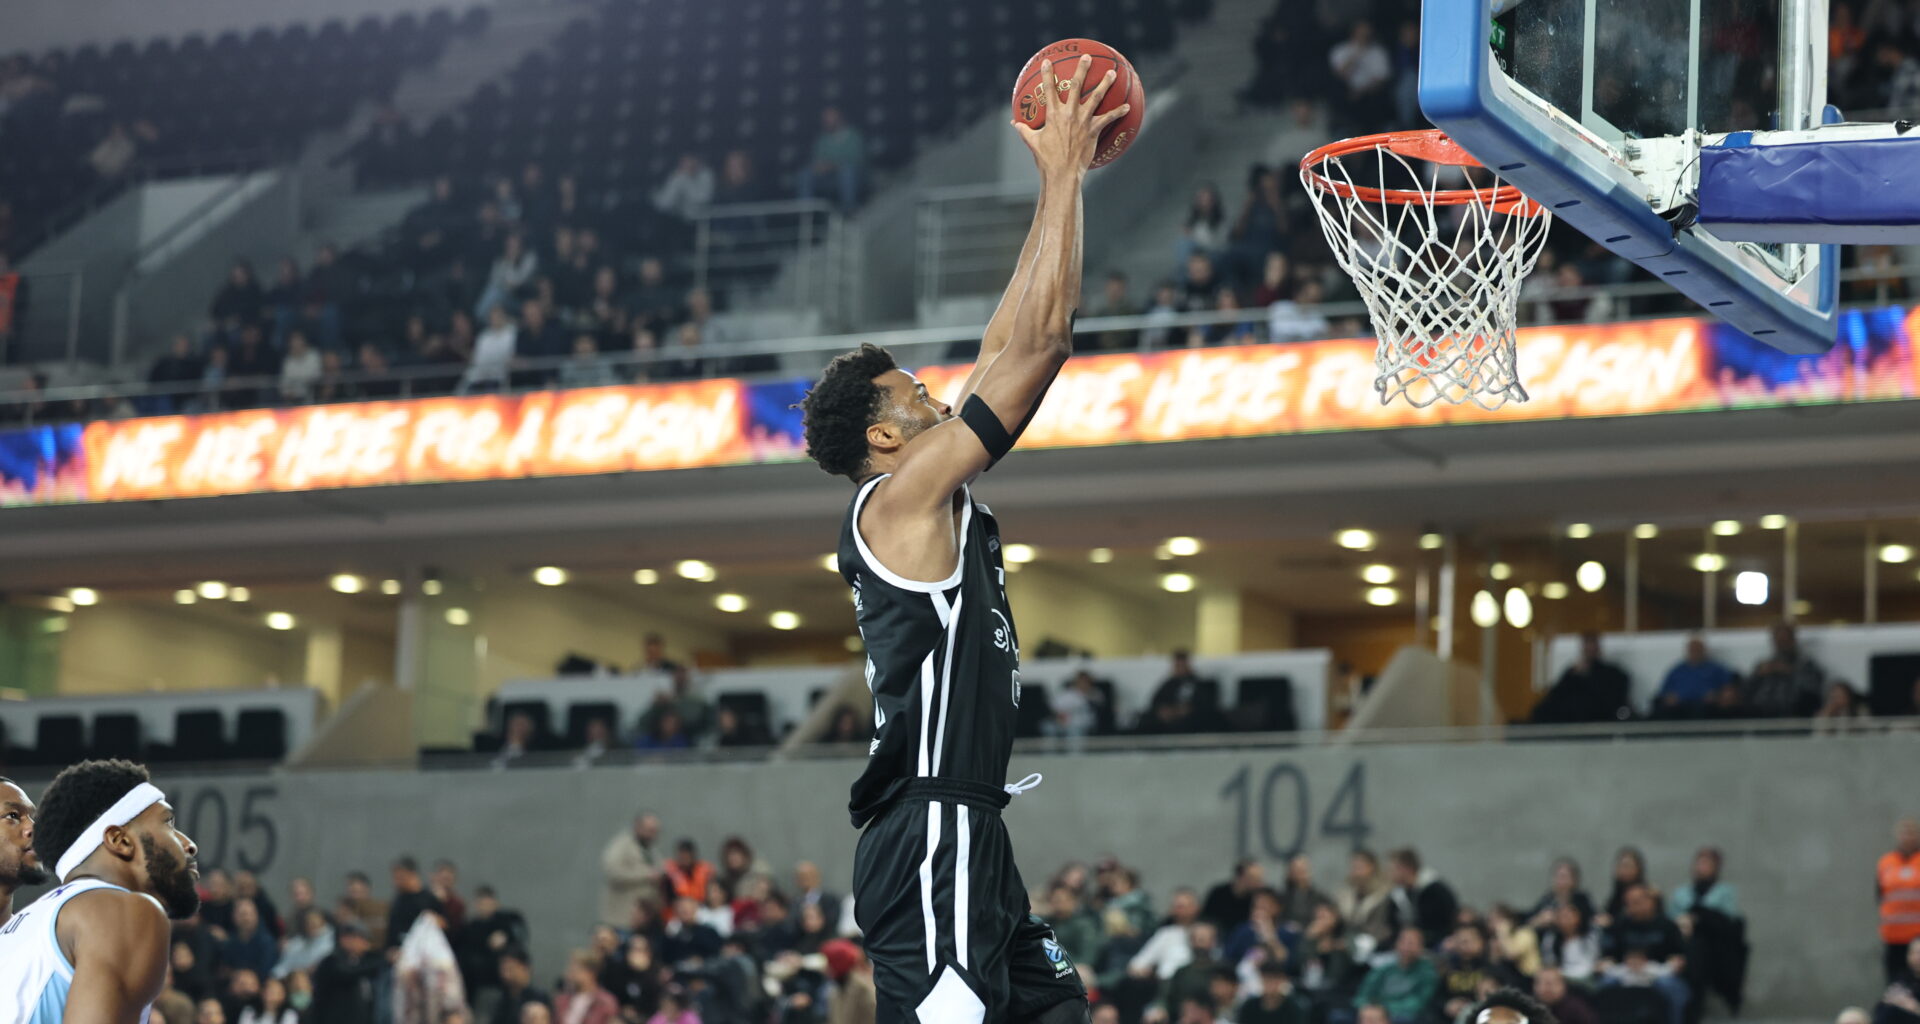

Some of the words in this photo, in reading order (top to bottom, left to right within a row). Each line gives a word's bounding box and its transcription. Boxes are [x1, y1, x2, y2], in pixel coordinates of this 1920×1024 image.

[98, 423, 182, 489] WE
[180, 417, 278, 489] ARE
[275, 408, 409, 487] HERE
[408, 408, 500, 470] FOR
[503, 406, 545, 473] A
[550, 388, 737, 463] REASON
[1141, 352, 1300, 436] HERE
[1218, 759, 1374, 864] 104
